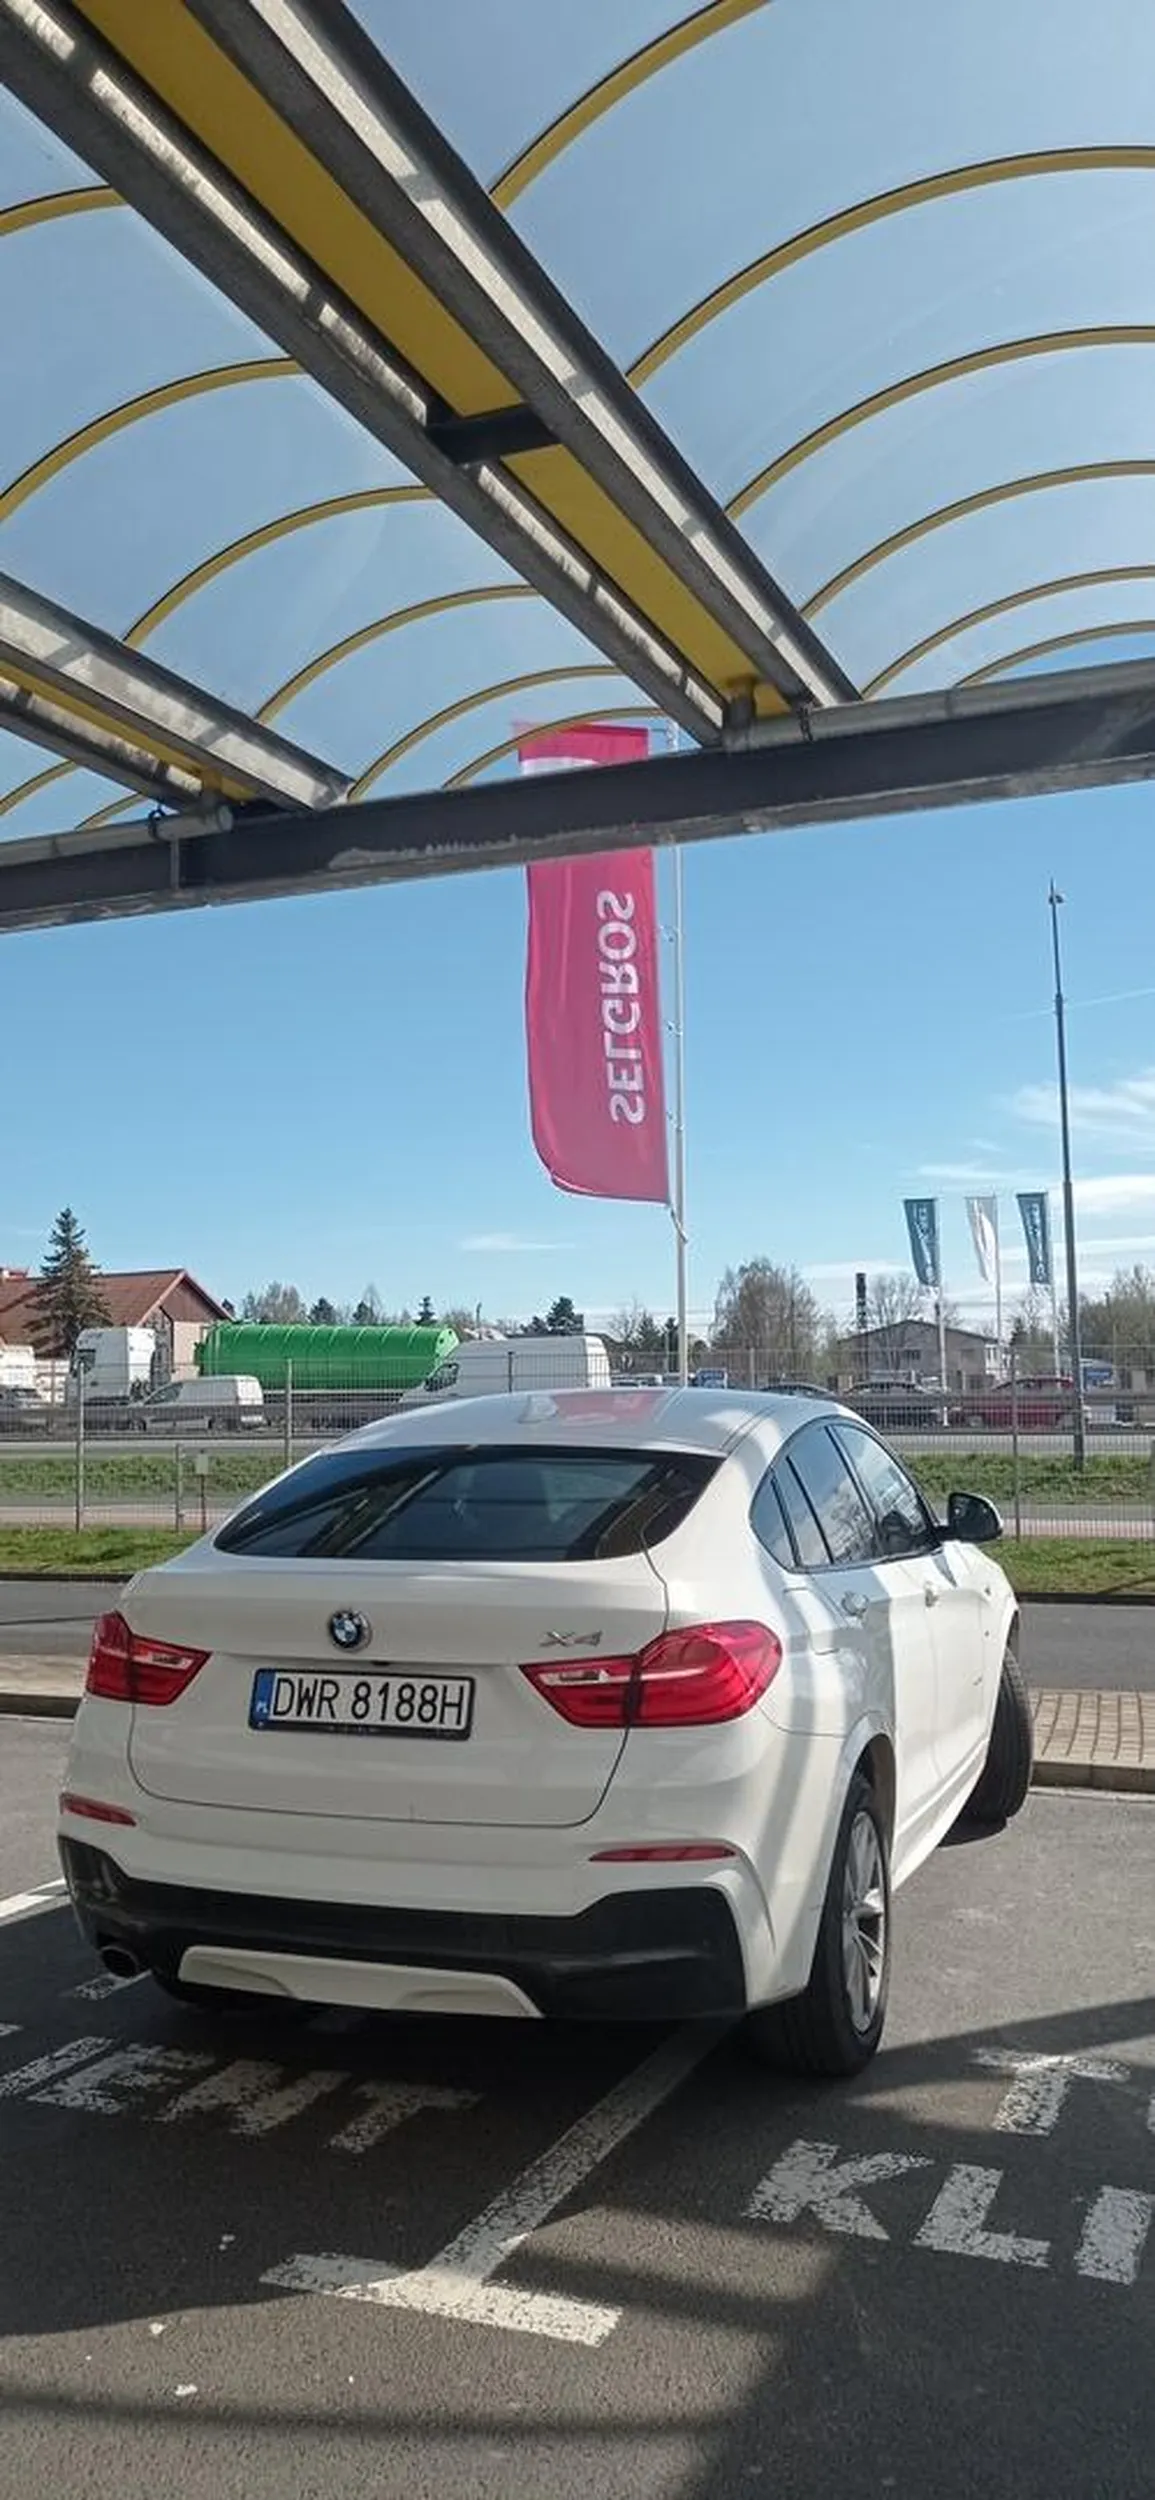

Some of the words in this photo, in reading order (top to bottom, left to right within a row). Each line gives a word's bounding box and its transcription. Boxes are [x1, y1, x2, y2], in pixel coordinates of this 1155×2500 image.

[540, 1629, 603, 1648] X4
[272, 1677, 340, 1719] DWR
[351, 1681, 465, 1726] 8188H
[0, 2023, 484, 2154] IENT
[963, 2047, 1155, 2136] T
[741, 2138, 1155, 2286] KLI
